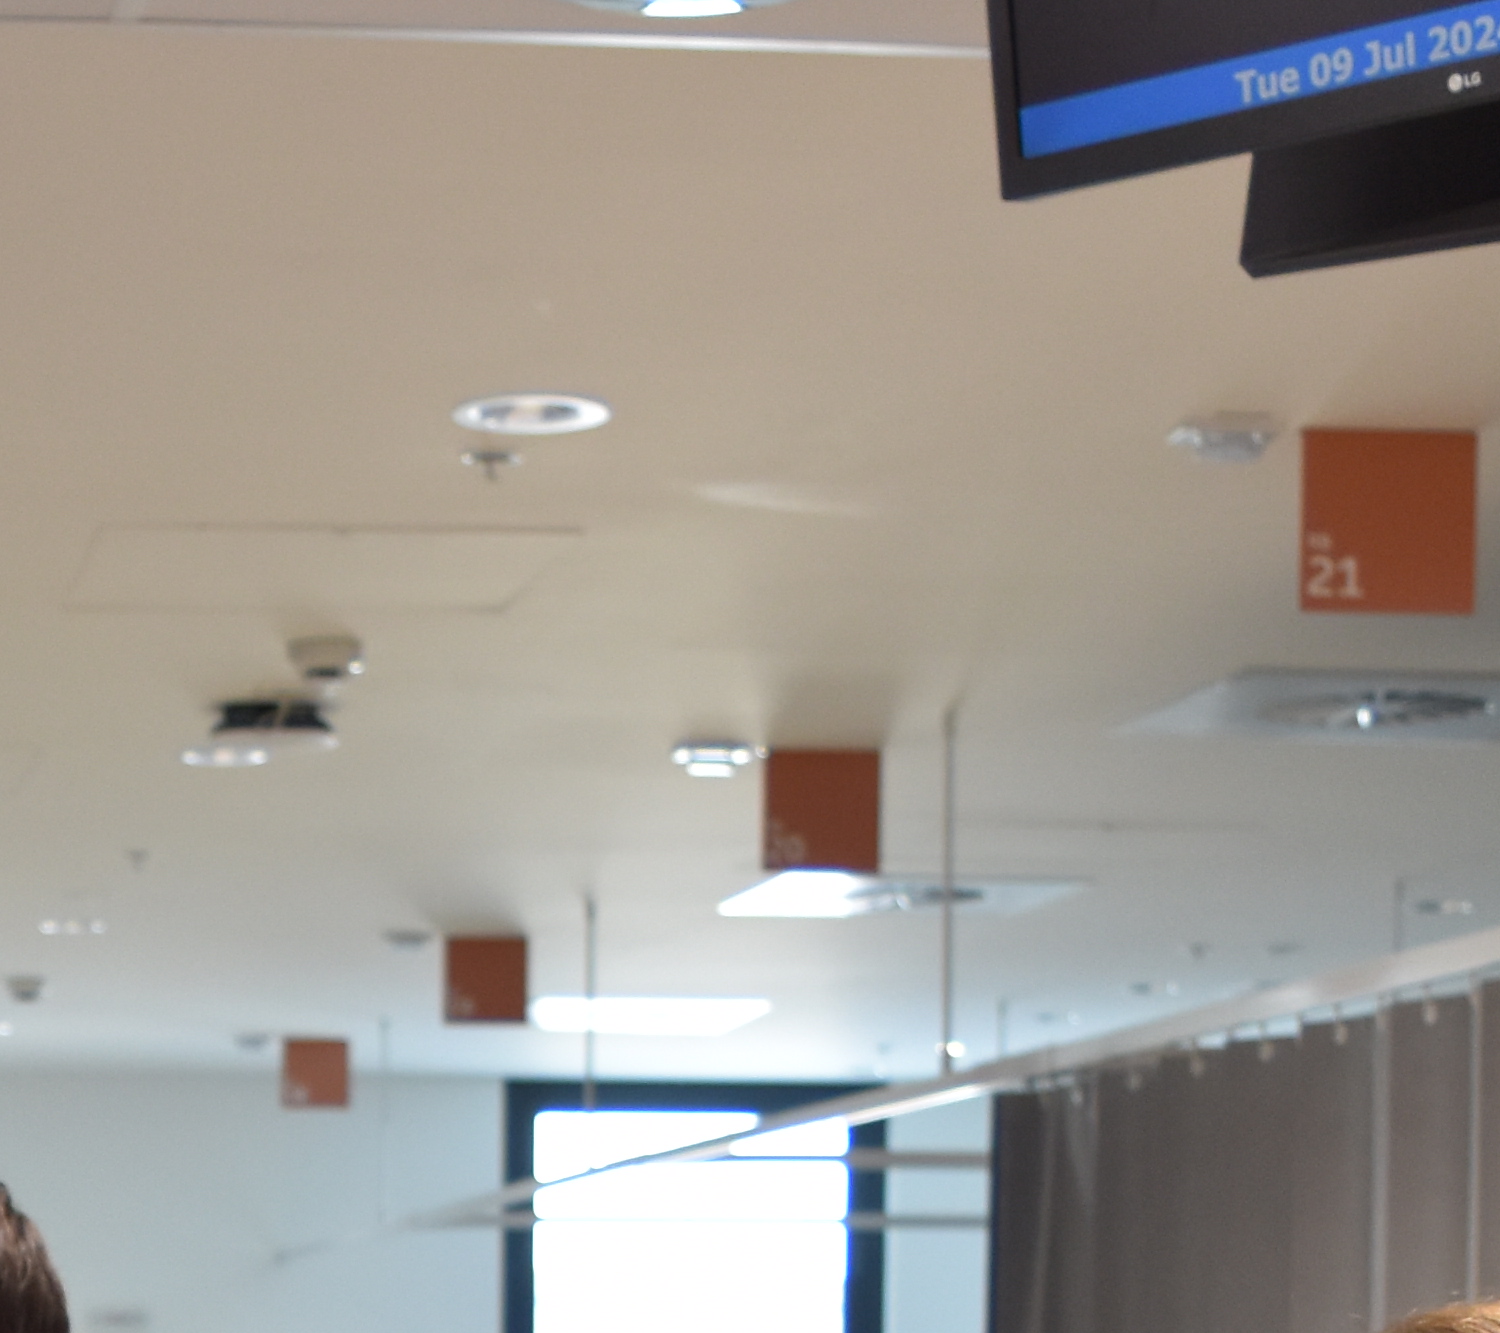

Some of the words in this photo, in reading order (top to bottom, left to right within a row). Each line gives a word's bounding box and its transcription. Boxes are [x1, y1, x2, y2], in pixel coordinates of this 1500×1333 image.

[1233, 66, 1300, 104] Tue
[1309, 47, 1354, 88] 09
[1363, 31, 1416, 78] Jul
[1306, 554, 1365, 599] 21
